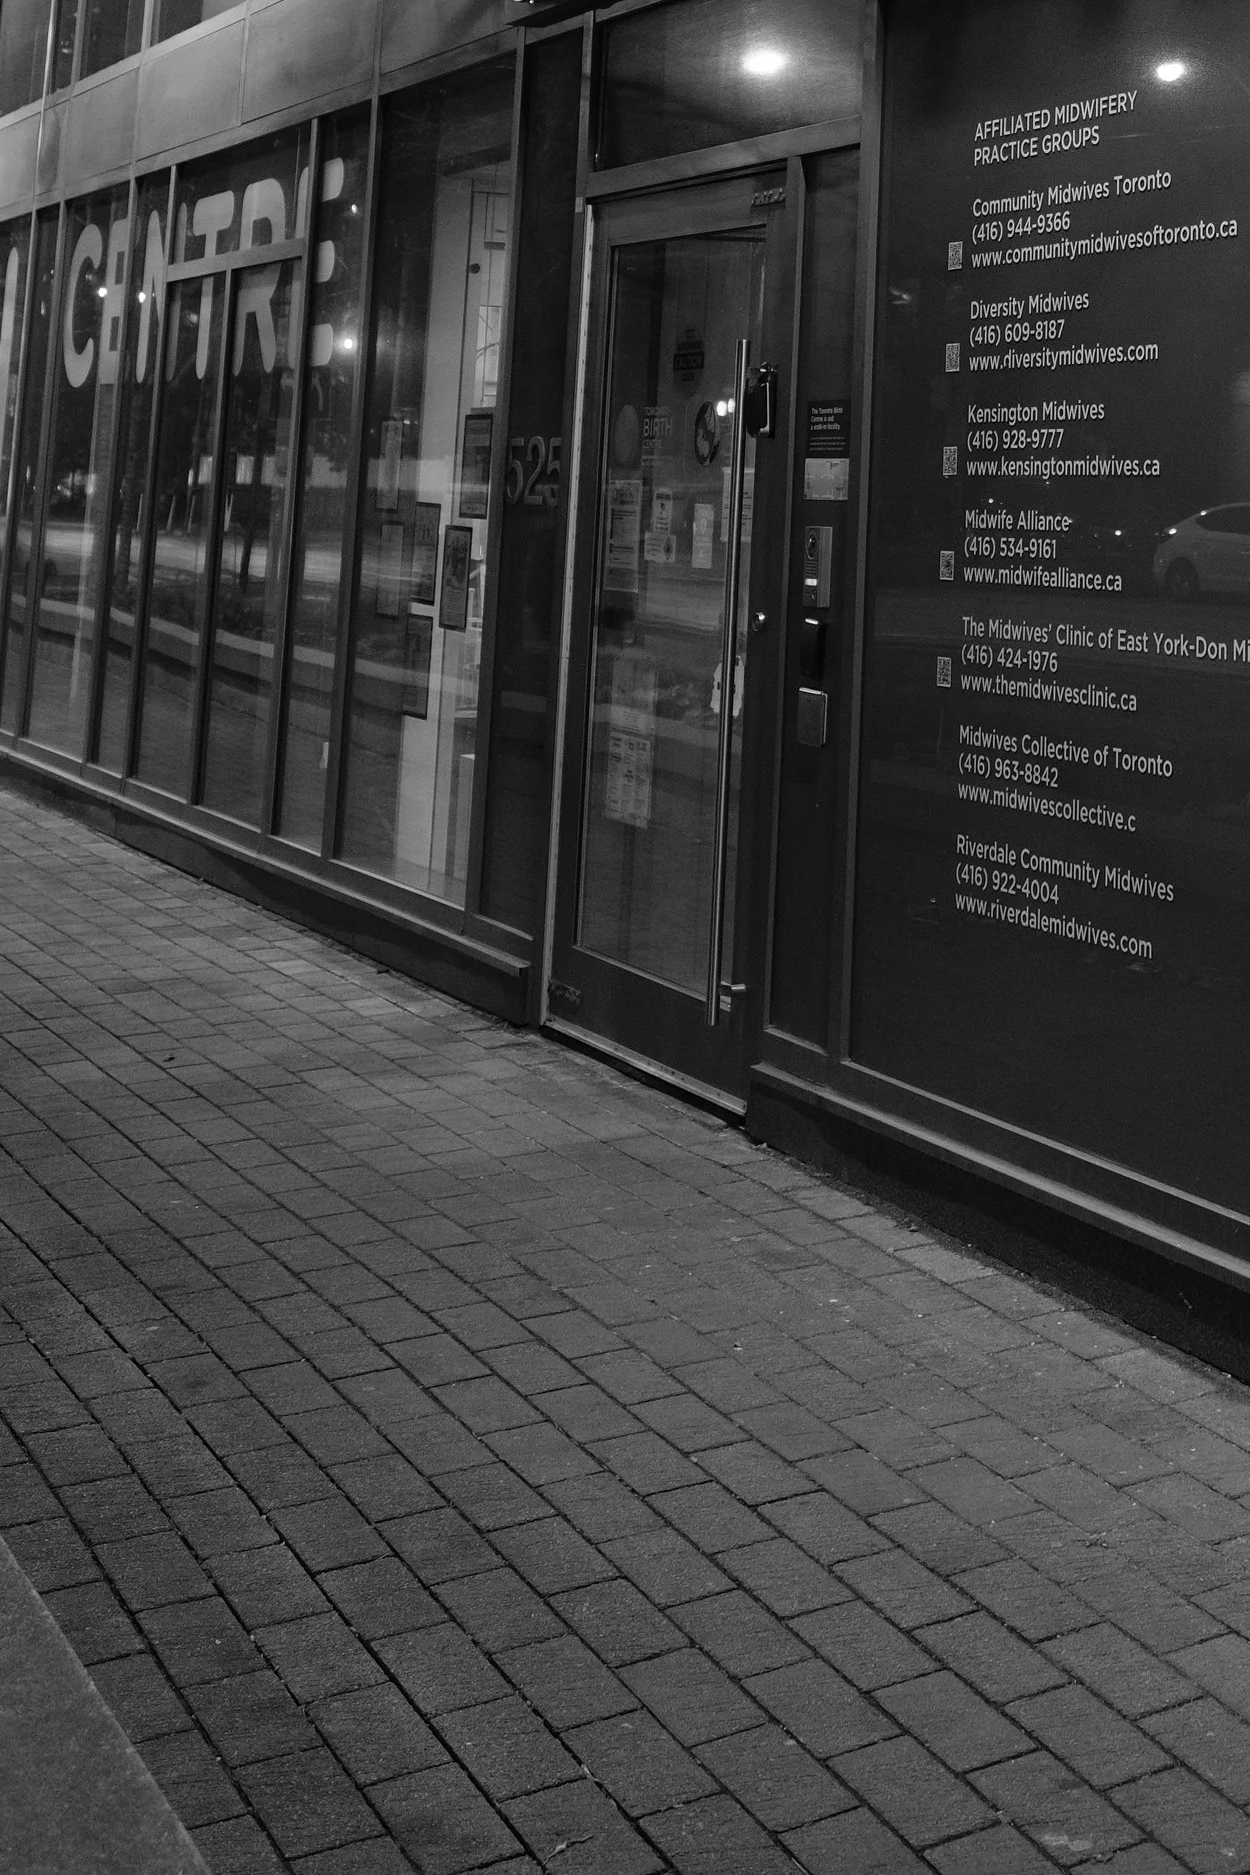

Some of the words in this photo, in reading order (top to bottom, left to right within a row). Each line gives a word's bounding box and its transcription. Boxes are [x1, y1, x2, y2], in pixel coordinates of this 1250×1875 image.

[974, 109, 1051, 141] AFFILIATED
[1054, 89, 1138, 126] MIDWIFERY
[974, 136, 1038, 167] PRACTICE
[1041, 125, 1100, 154] GROUPS
[972, 189, 1044, 217] Community
[1047, 180, 1110, 206] Midwives
[1113, 169, 1172, 195] Toronto
[971, 219, 1238, 268] www.communitymidwivesoftoronto.ca
[972, 220, 1004, 246] (416)
[1007, 210, 1071, 238] 944-9366
[970, 296, 1025, 320] Diversity
[1028, 292, 1090, 314] Midwives
[969, 324, 1001, 348] (416)
[1004, 318, 1065, 343] 609-8187
[643, 417, 673, 437] BIRTH
[968, 403, 1038, 426] Kensington
[1042, 399, 1105, 421] Midwives
[967, 430, 999, 453] (416)
[1002, 428, 1064, 449] 928-9777
[506, 435, 560, 507] 525
[966, 454, 1160, 480] www.kensingtonmidwives.ca
[965, 508, 1014, 530] Midwife
[1016, 509, 1071, 532] Alliance
[964, 536, 996, 559] (416)
[999, 537, 1056, 559] 534-9161
[963, 564, 1122, 592] www.midwifealliance.ca
[962, 616, 985, 637] The
[1056, 624, 1094, 648] Clinic
[1098, 627, 1114, 649] of
[1117, 629, 1149, 653] East
[1153, 632, 1227, 660] York-Don
[961, 643, 993, 668] (416)
[997, 647, 1058, 673] 424-1976
[960, 674, 1137, 711] www.themidwivesclinic.ca
[959, 724, 1018, 753] Midwives
[1021, 734, 1090, 764] Collective
[1093, 745, 1109, 767] of
[1112, 747, 1173, 777] Toronto
[958, 752, 991, 779] (416)
[994, 757, 1059, 788] 963-8842
[958, 783, 1136, 832] www.midwivescollective.c
[956, 834, 1017, 866] Riverdale
[1020, 848, 1100, 888] Community
[1104, 865, 1174, 902] Midwives
[956, 862, 988, 891] (416)
[992, 870, 1060, 905] 922-4004
[955, 893, 1152, 959] www.riverdalemidwives.com
